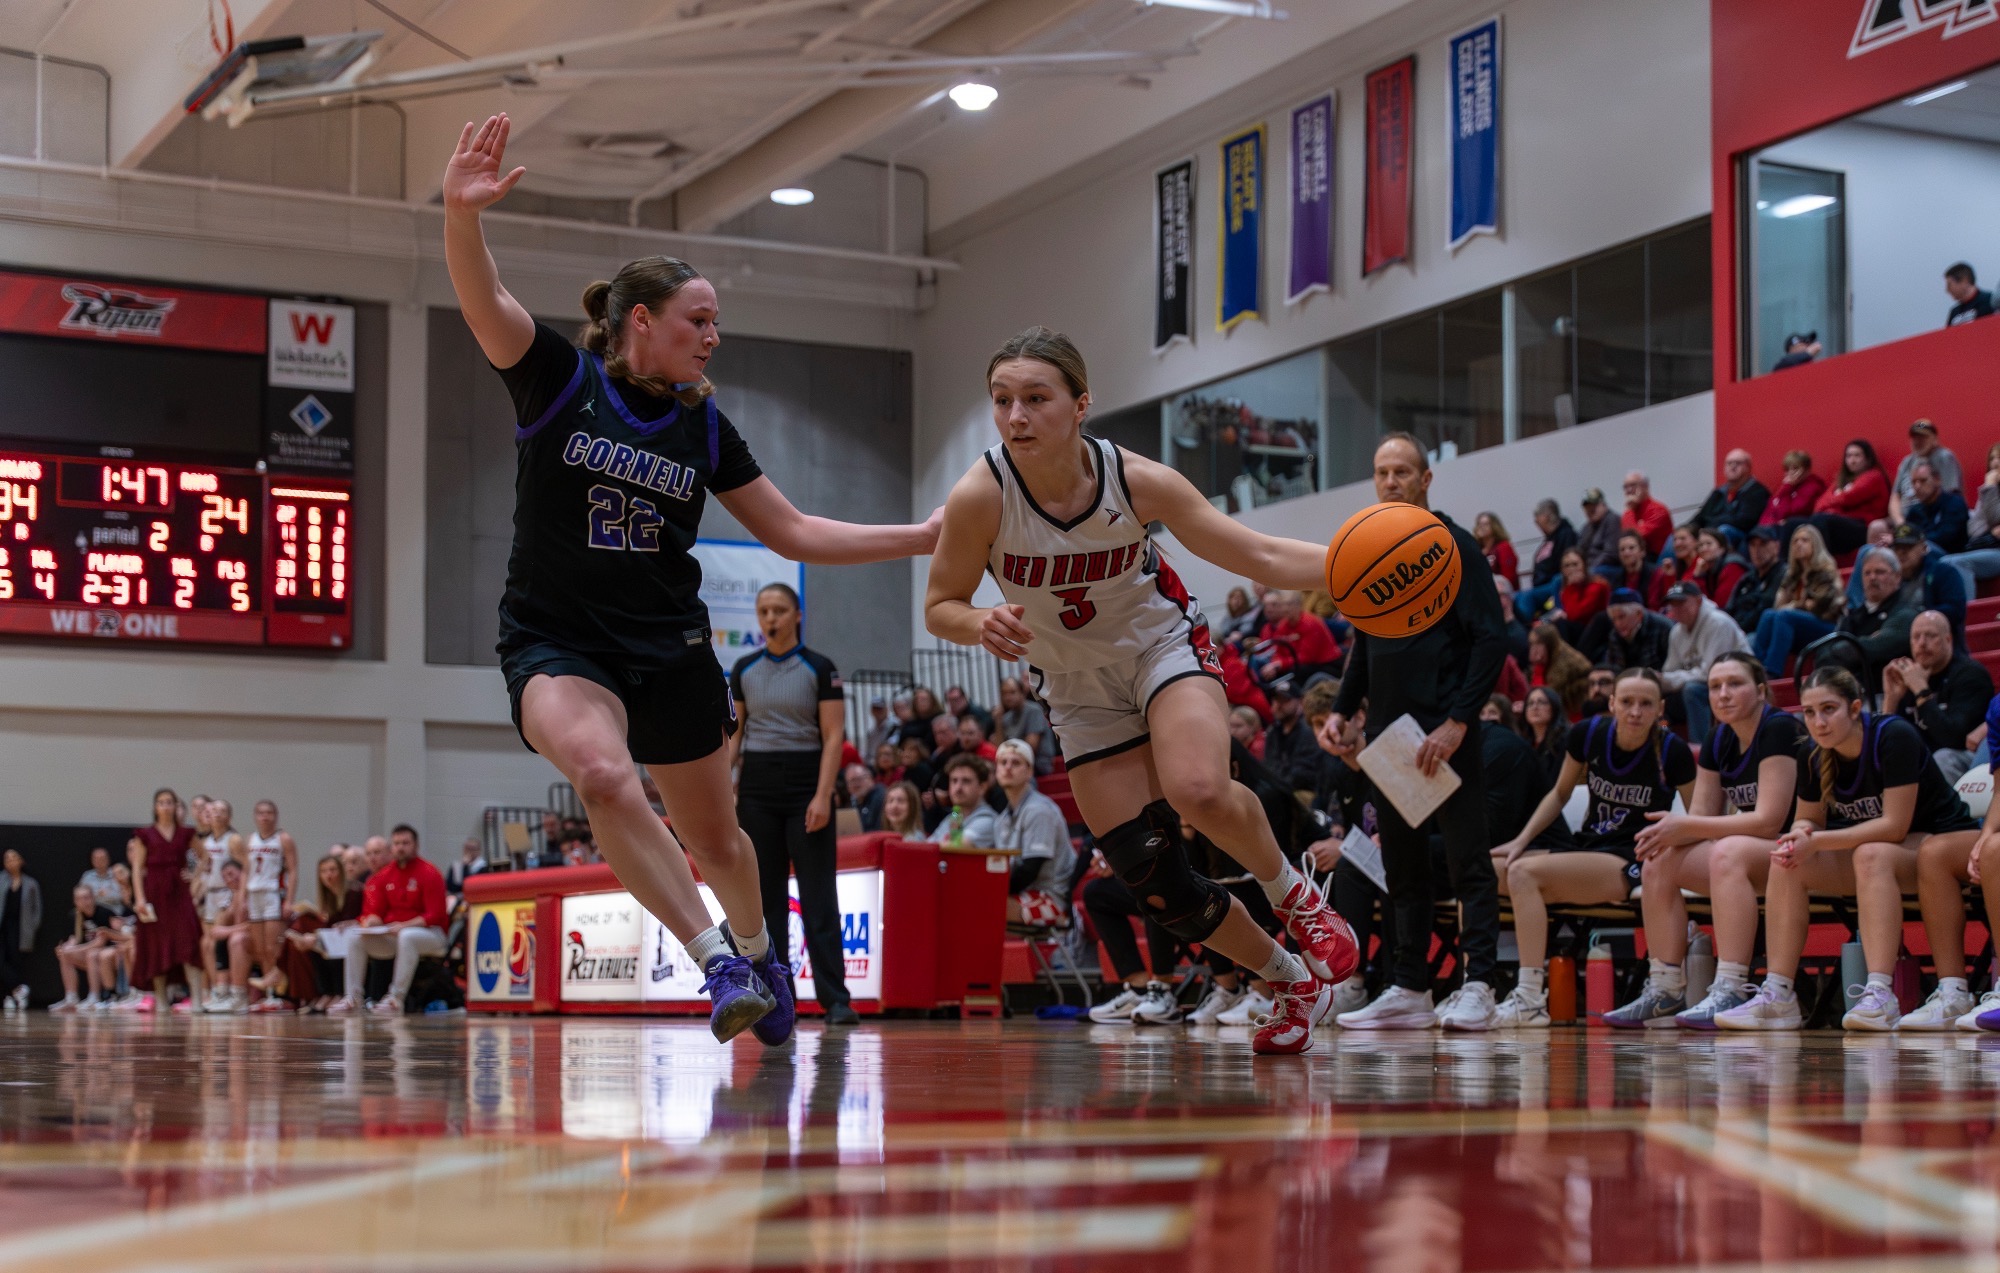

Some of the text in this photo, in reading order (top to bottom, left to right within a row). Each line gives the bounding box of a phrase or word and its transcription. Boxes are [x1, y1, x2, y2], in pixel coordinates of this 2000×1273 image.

[1474, 30, 1493, 133] ILLINOIS
[290, 312, 335, 346] W
[102, 465, 168, 506] 1:47
[562, 431, 696, 501] CORNELL
[201, 494, 248, 535] 24
[588, 483, 664, 551] 22
[92, 526, 140, 546] period
[150, 521, 169, 552] 2
[1003, 541, 1140, 588] RED HAWKS
[1361, 541, 1447, 606] Wilson
[34, 571, 55, 600] 4
[174, 578, 195, 609] 2
[230, 581, 250, 612] 5
[50, 609, 92, 633] WE
[124, 613, 179, 637] ONE
[1051, 586, 1097, 631] 3
[1407, 585, 1451, 628] EVO
[1958, 782, 1988, 793] RED
[841, 912, 869, 955] AA
